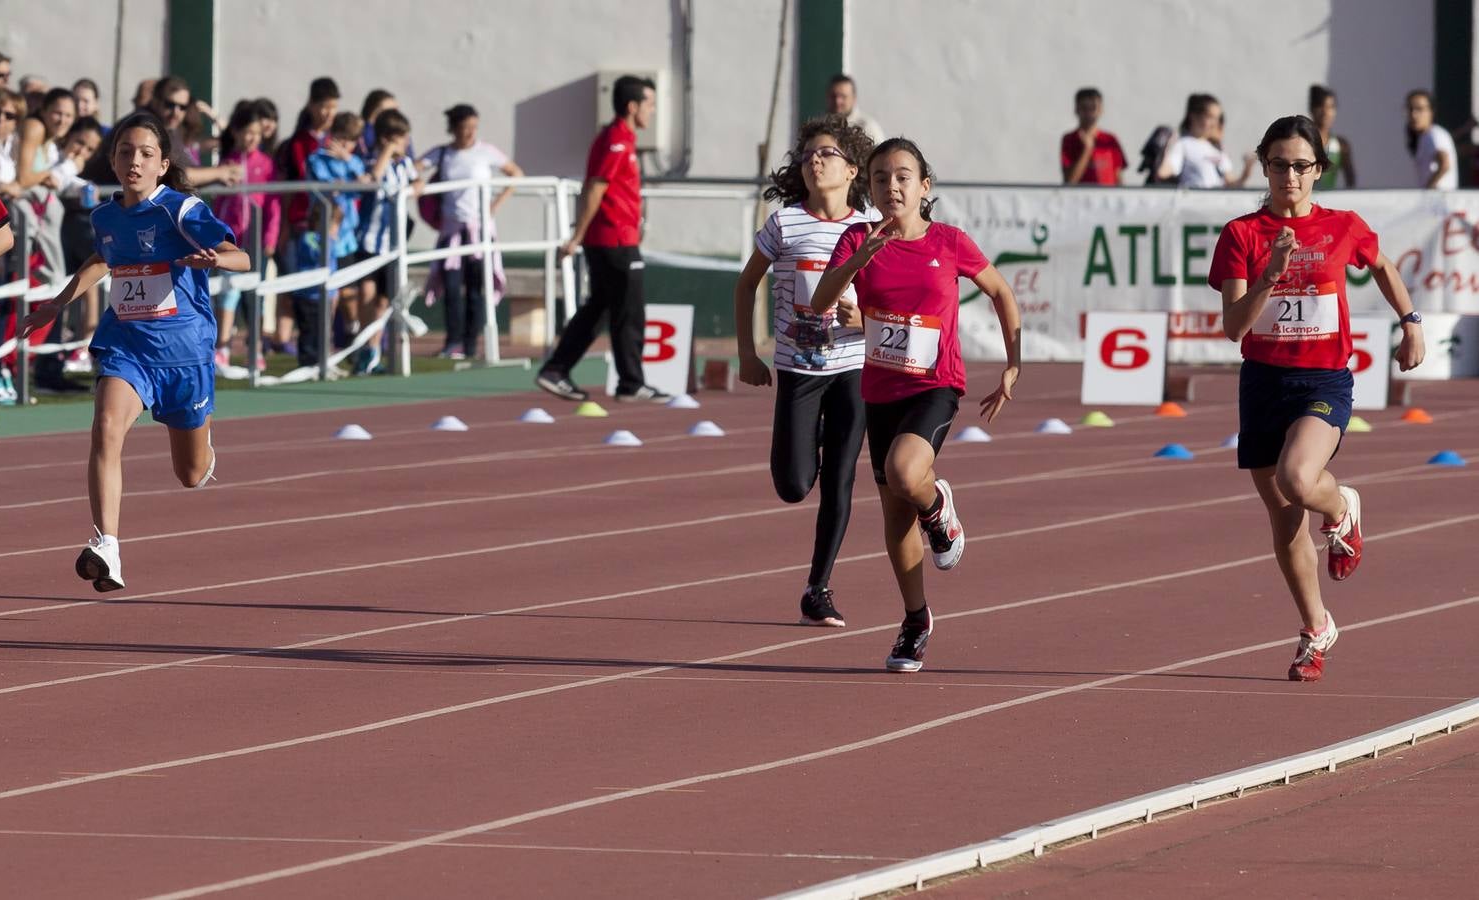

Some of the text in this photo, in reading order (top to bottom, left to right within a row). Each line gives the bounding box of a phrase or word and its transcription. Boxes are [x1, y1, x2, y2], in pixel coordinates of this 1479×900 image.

[1083, 225, 1224, 286] ATLE
[122, 280, 146, 301] 24
[1277, 300, 1305, 321] 21
[879, 326, 909, 350] 22
[1100, 328, 1150, 370] 6
